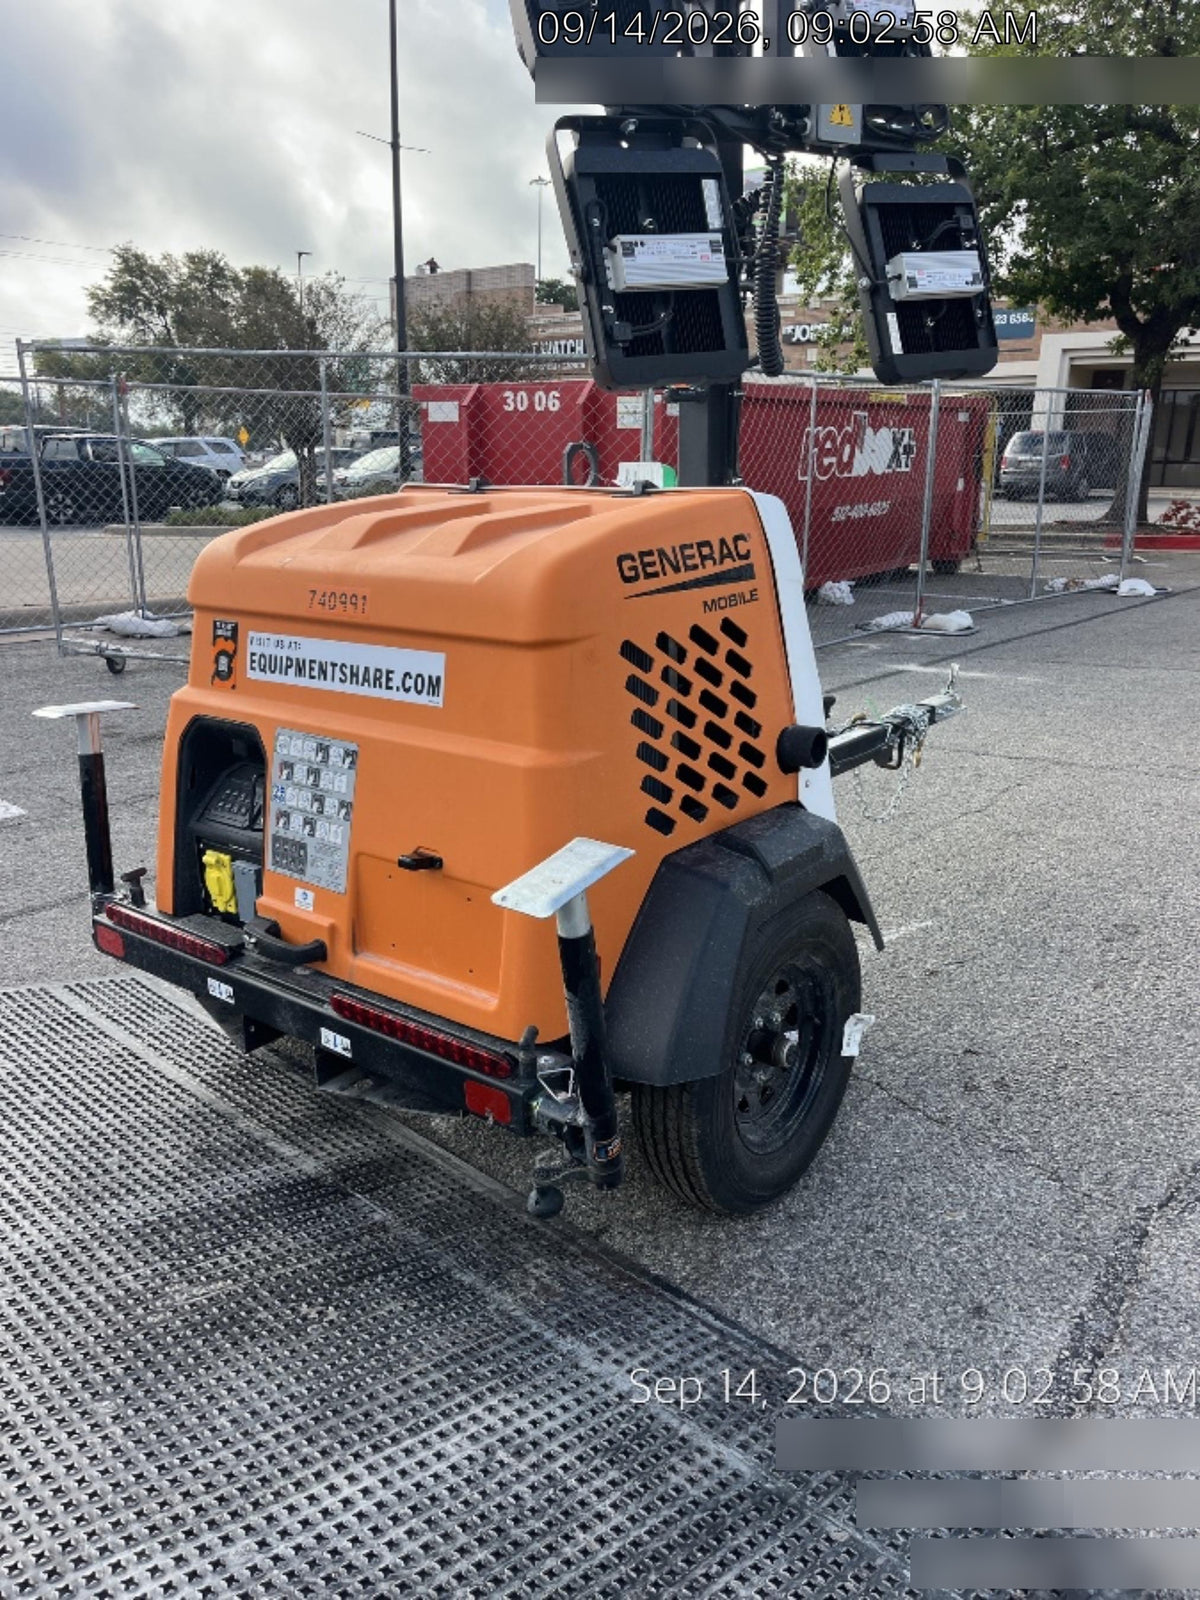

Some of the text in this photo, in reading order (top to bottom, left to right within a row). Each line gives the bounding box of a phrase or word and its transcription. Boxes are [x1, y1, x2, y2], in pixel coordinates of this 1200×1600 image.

[503, 391, 561, 412] 30 06
[616, 533, 751, 584] GENERAC
[308, 589, 368, 615] 740991
[703, 588, 760, 614] MOBILE
[249, 651, 442, 698] EQUIPMENTSHARE.COM
